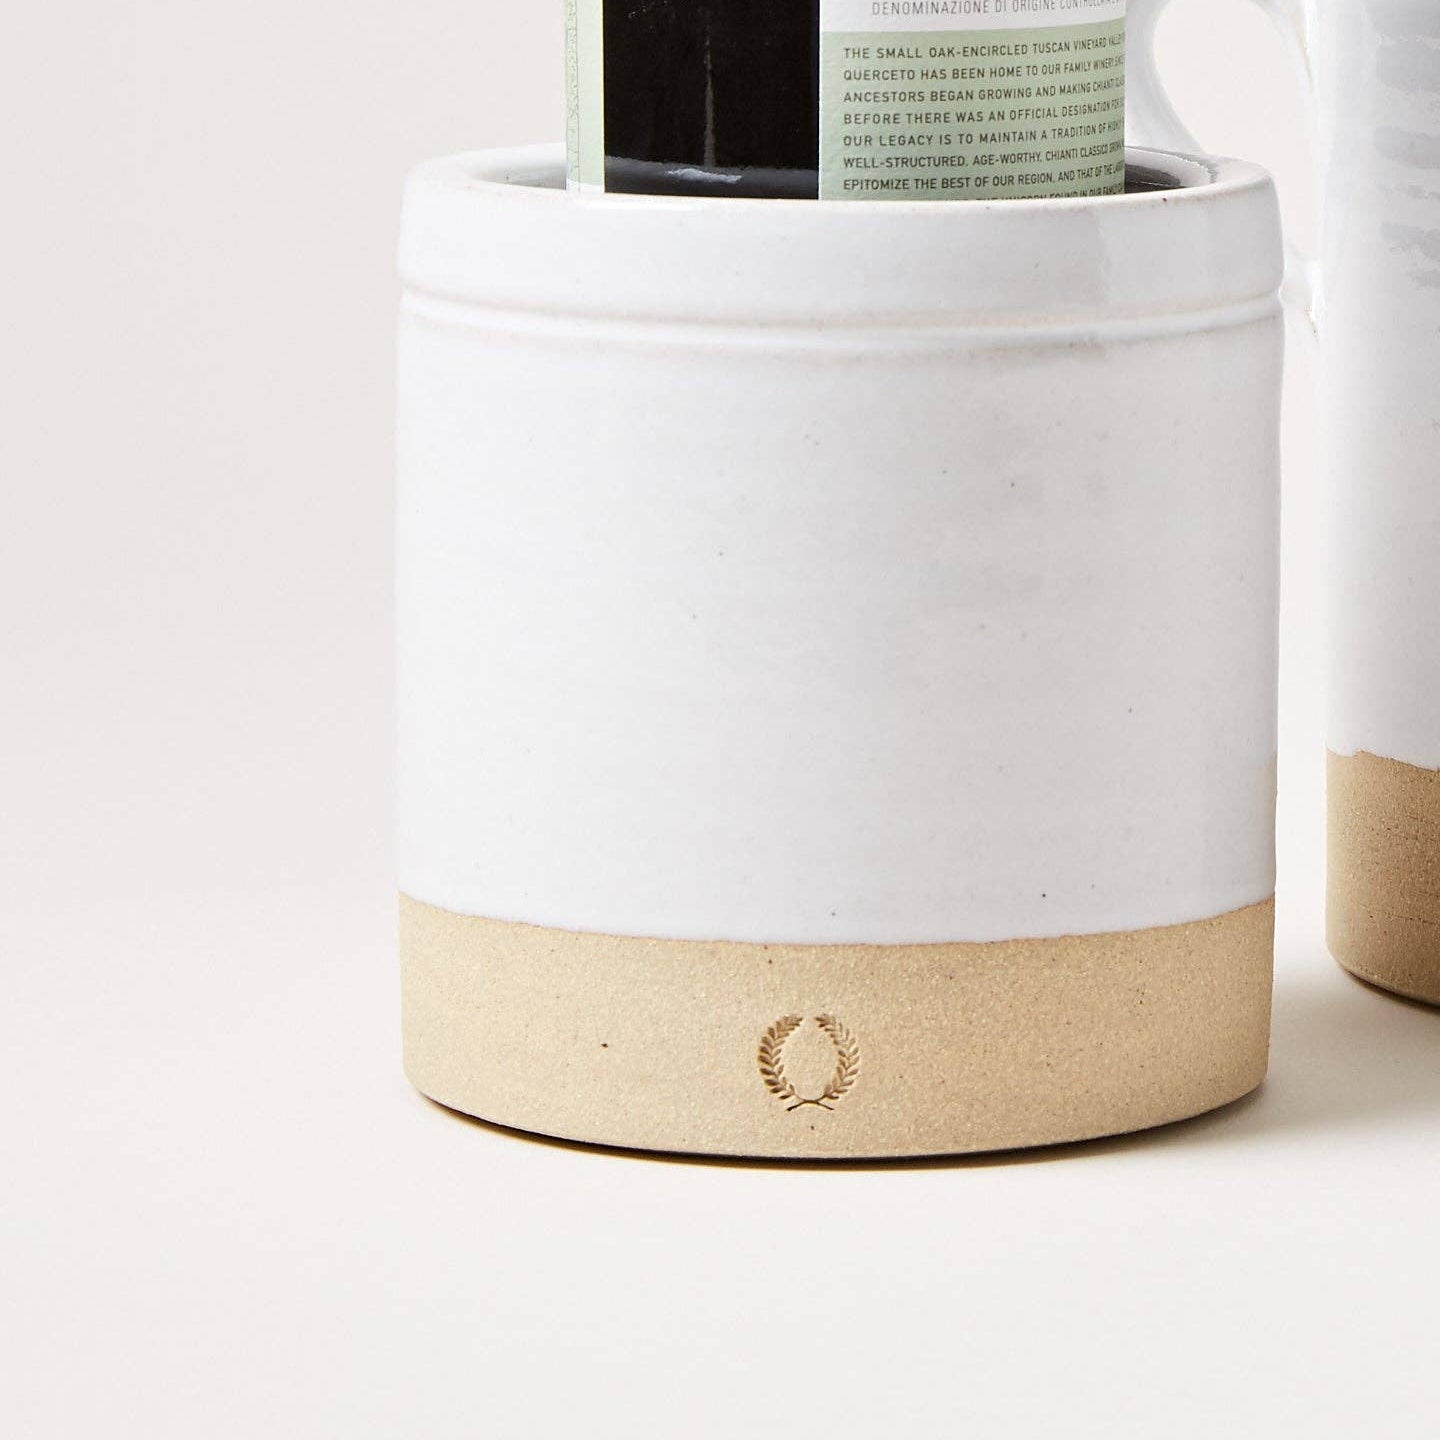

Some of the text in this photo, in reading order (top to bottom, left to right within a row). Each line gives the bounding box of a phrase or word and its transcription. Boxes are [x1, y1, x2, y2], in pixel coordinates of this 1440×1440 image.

[872, 0, 989, 16] DENOMINAZIONE
[995, 0, 1007, 14] DI
[843, 47, 870, 59] THE
[876, 47, 923, 59] SMALL
[929, 44, 1028, 58] OAK-ENCIRCLED
[1033, 41, 1070, 54] TUSCAN
[1073, 37, 1106, 51] VINEYARD
[843, 69, 916, 81] QUERCETO
[921, 69, 947, 80] HAS
[952, 68, 985, 80] BEEN
[989, 65, 1022, 78] HOME
[1026, 65, 1038, 77] TO
[1041, 63, 1061, 75] OUR
[1064, 60, 1091, 74] FAMILY
[843, 91, 925, 103] ANCESTORS
[930, 90, 974, 102] BEGAN
[978, 87, 1032, 100] GROWING
[1035, 85, 1056, 98] AND
[1059, 82, 1091, 95] MAKING
[844, 113, 901, 125] BEFORE
[906, 112, 950, 124] THERE
[956, 111, 984, 123] WAS
[988, 110, 1005, 122] AN
[1009, 107, 1058, 120] OFFICIAL
[1062, 100, 1110, 117] DESIGNATION
[843, 135, 873, 147] OUR
[879, 135, 933, 147] LEGACY
[939, 134, 952, 145] IS
[958, 133, 974, 144] TO
[979, 130, 1037, 144] MAINTAIN
[1041, 129, 1048, 140] A
[1052, 124, 1096, 139] TRADITION
[1098, 122, 1107, 134] OF
[1045, 148, 1078, 161] CHIANTI
[1080, 143, 1108, 158] CLASSICO
[843, 178, 909, 191] EPITOMIZE
[914, 178, 937, 190] THE
[941, 177, 971, 189] BEST
[974, 176, 989, 188] OF
[992, 174, 1015, 187] OUR
[1058, 170, 1075, 183] AND
[1077, 166, 1094, 180] THAT
